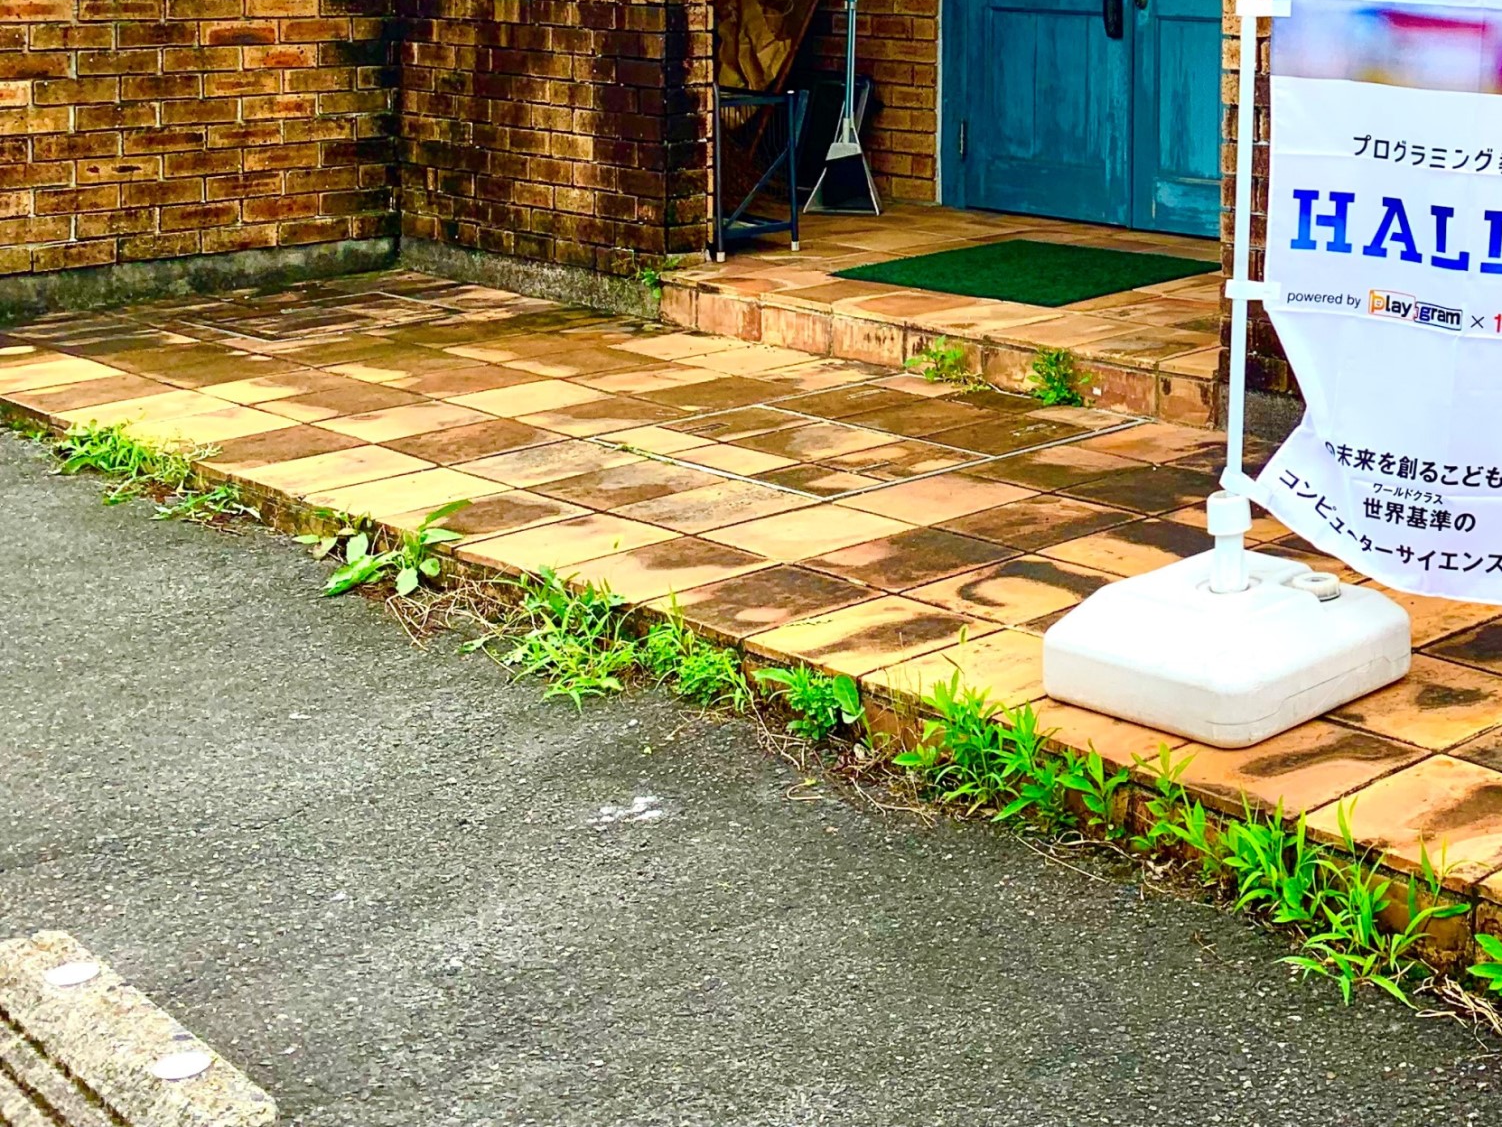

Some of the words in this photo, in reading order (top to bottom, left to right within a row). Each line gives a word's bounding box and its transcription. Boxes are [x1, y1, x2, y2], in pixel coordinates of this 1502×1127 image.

[1287, 289, 1343, 306] powered
[1346, 293, 1361, 309] by
[1373, 482, 1444, 506] ワールドクラス
[1362, 496, 1476, 533] 世界基準の
